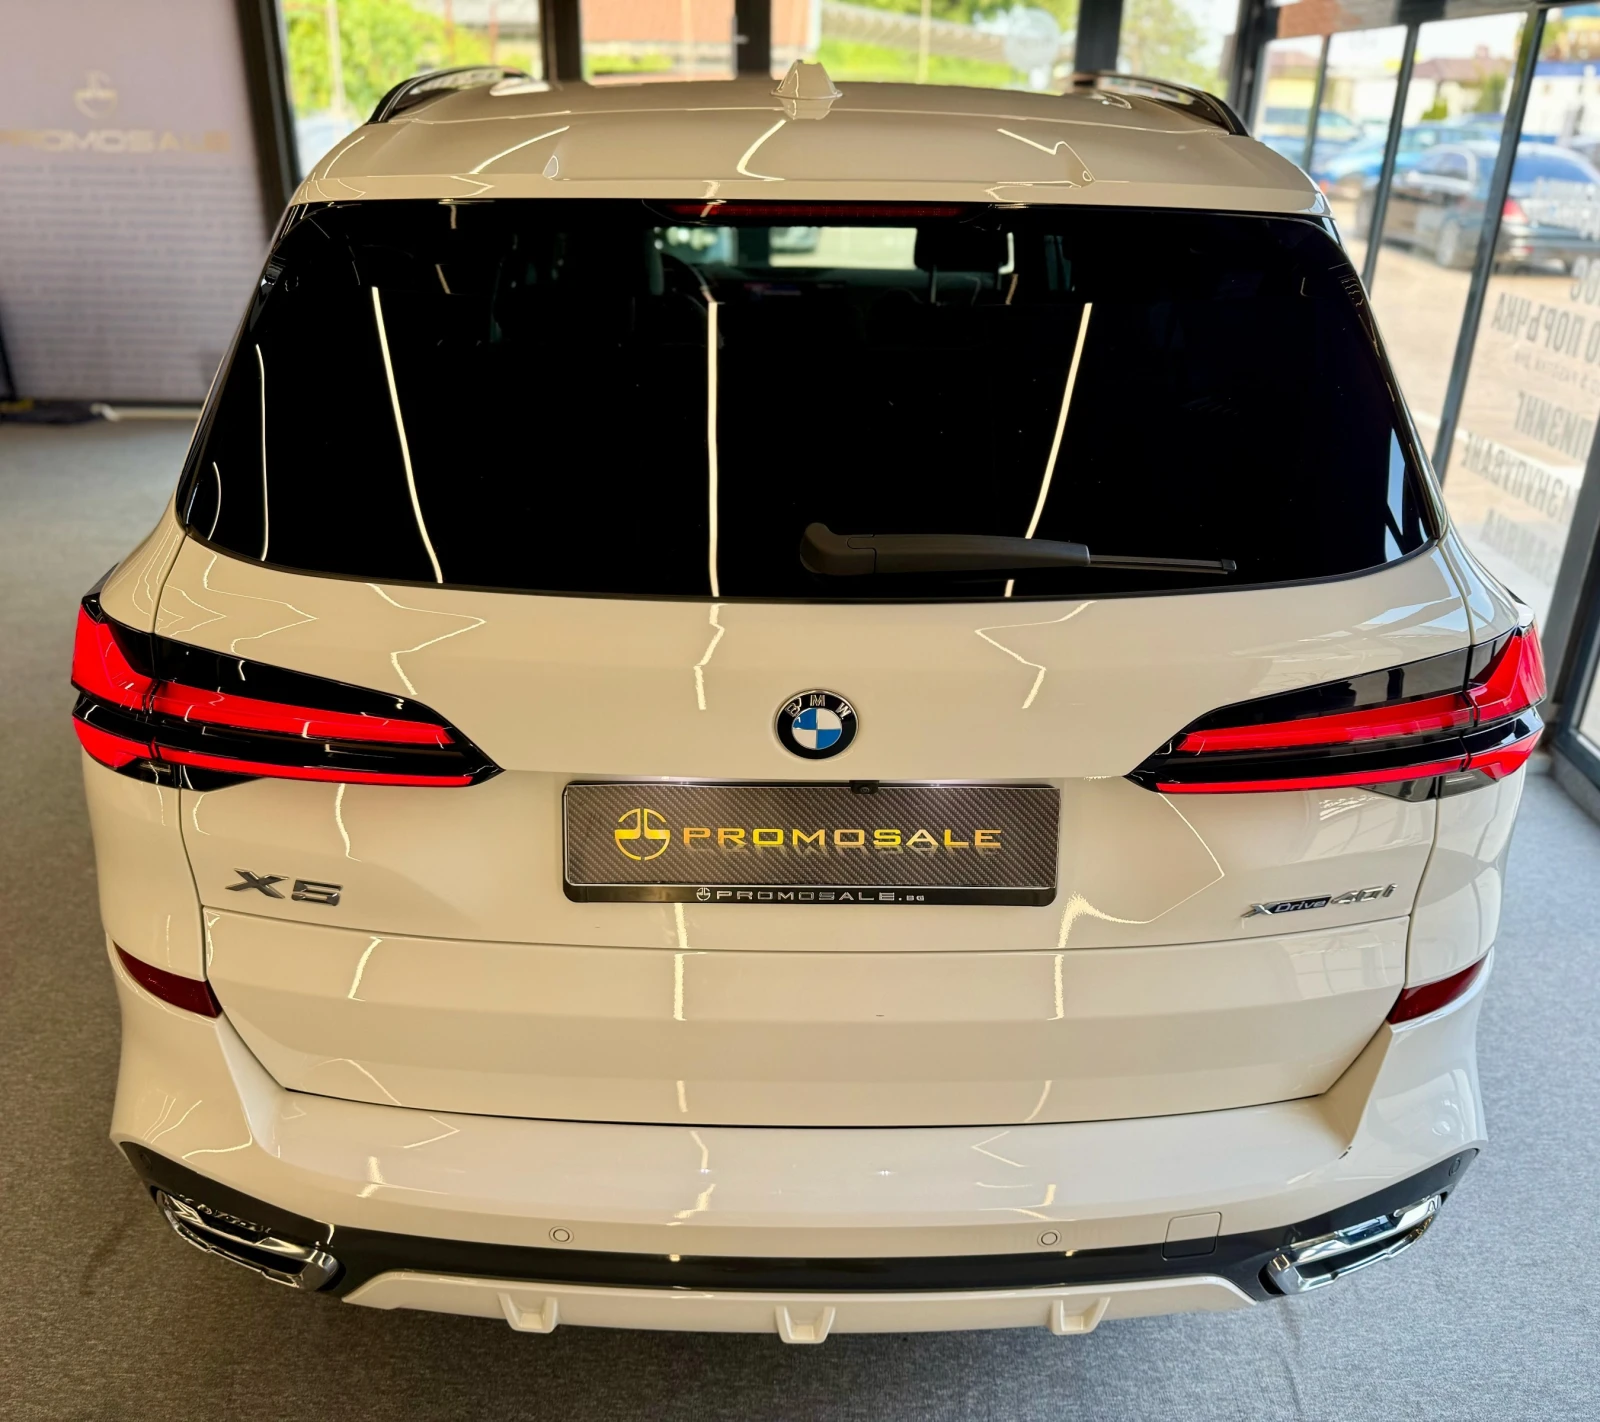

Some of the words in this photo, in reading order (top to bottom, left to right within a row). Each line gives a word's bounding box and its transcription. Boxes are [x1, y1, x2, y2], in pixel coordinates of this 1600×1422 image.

[785, 694, 852, 720] BMW
[683, 827, 1001, 847] PROMOSALE
[225, 867, 343, 907] X5
